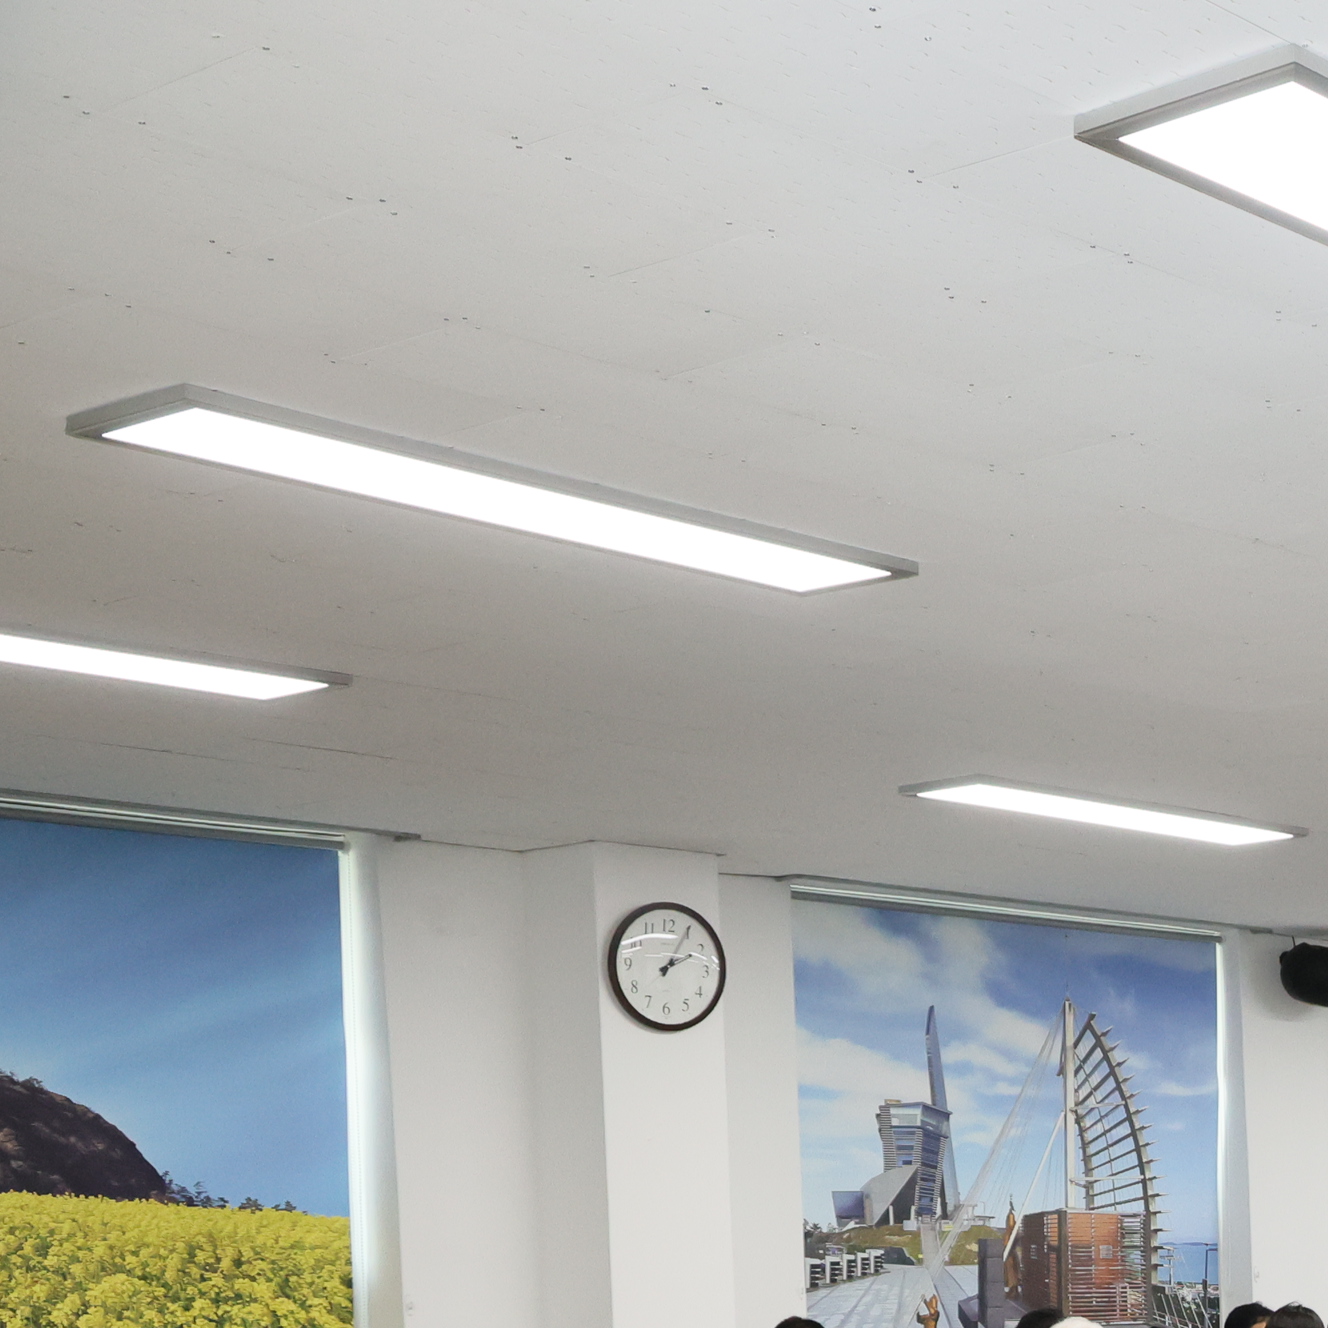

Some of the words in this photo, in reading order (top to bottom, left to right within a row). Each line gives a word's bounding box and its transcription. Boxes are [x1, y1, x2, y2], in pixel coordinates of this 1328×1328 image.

[662, 919, 676, 933] 12
[624, 957, 633, 971] 9
[702, 965, 710, 979] 3
[630, 980, 639, 994] 8
[694, 986, 704, 998] 4
[644, 995, 653, 1009] 7
[662, 1002, 671, 1016] 6
[681, 998, 690, 1012] 5
